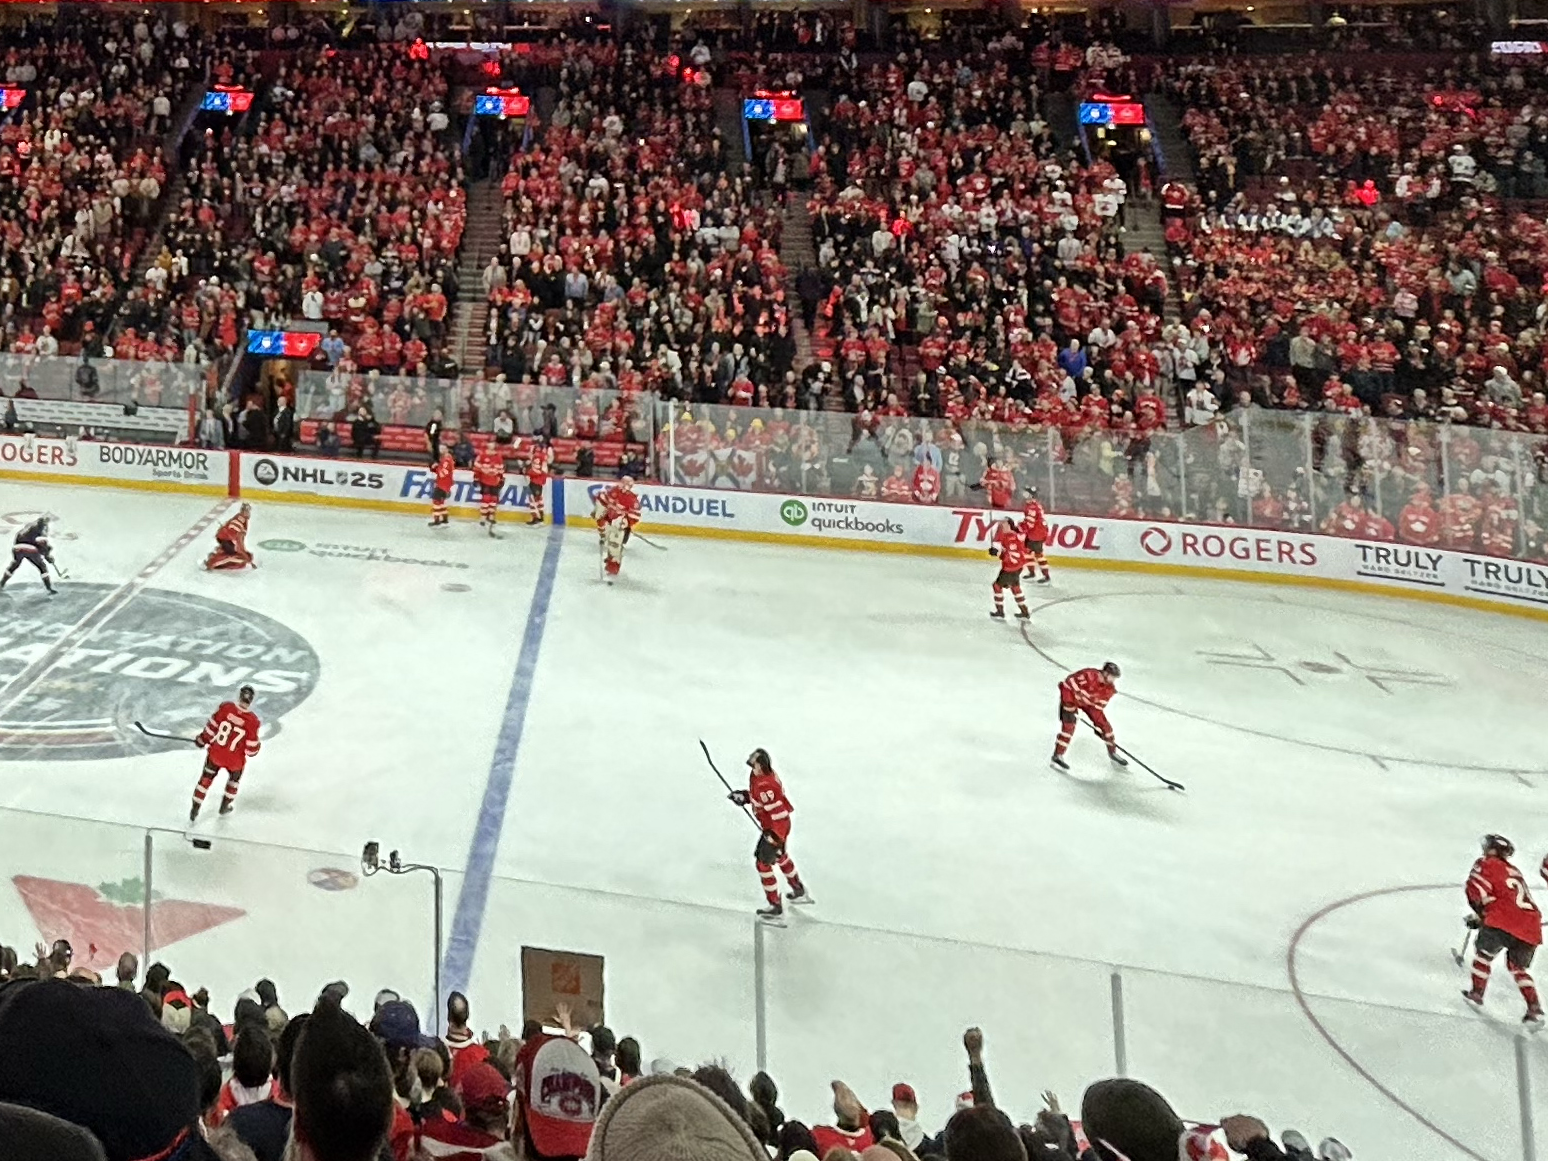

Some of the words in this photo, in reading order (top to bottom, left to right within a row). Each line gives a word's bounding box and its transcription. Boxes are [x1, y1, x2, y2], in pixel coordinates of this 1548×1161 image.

[100, 445, 209, 471] BODYARMOR
[282, 466, 334, 485] NHL
[350, 472, 384, 489] 25
[640, 490, 735, 518] ANDUEL
[811, 502, 857, 514] INTUIT
[811, 516, 903, 535] quickbooks
[1181, 533, 1317, 566] ROGERS
[1355, 544, 1443, 572] TRULY
[217, 721, 246, 751] 87
